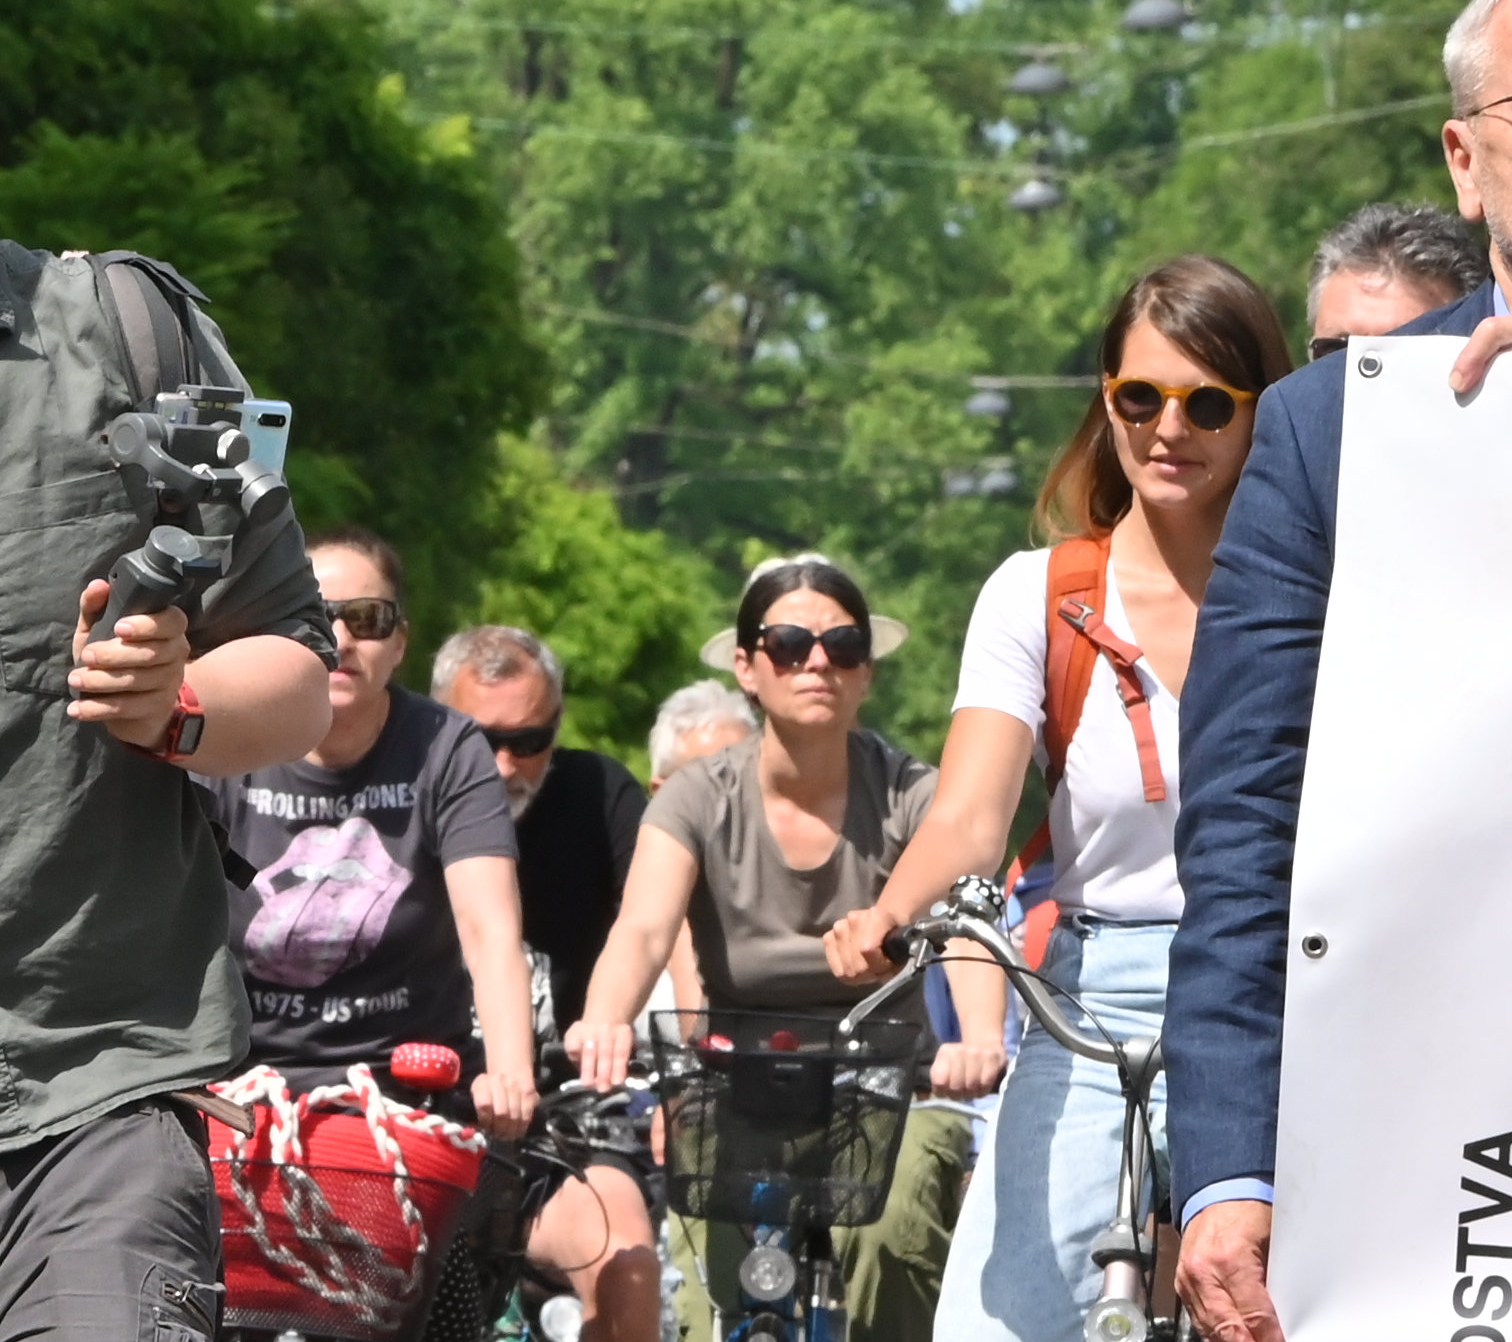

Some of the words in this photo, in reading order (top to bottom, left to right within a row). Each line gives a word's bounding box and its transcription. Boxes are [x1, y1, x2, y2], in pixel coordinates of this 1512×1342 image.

[255, 788, 349, 821] ROLLING
[252, 990, 306, 1019] 1975
[321, 996, 353, 1024] US
[354, 986, 410, 1019] TOUR
